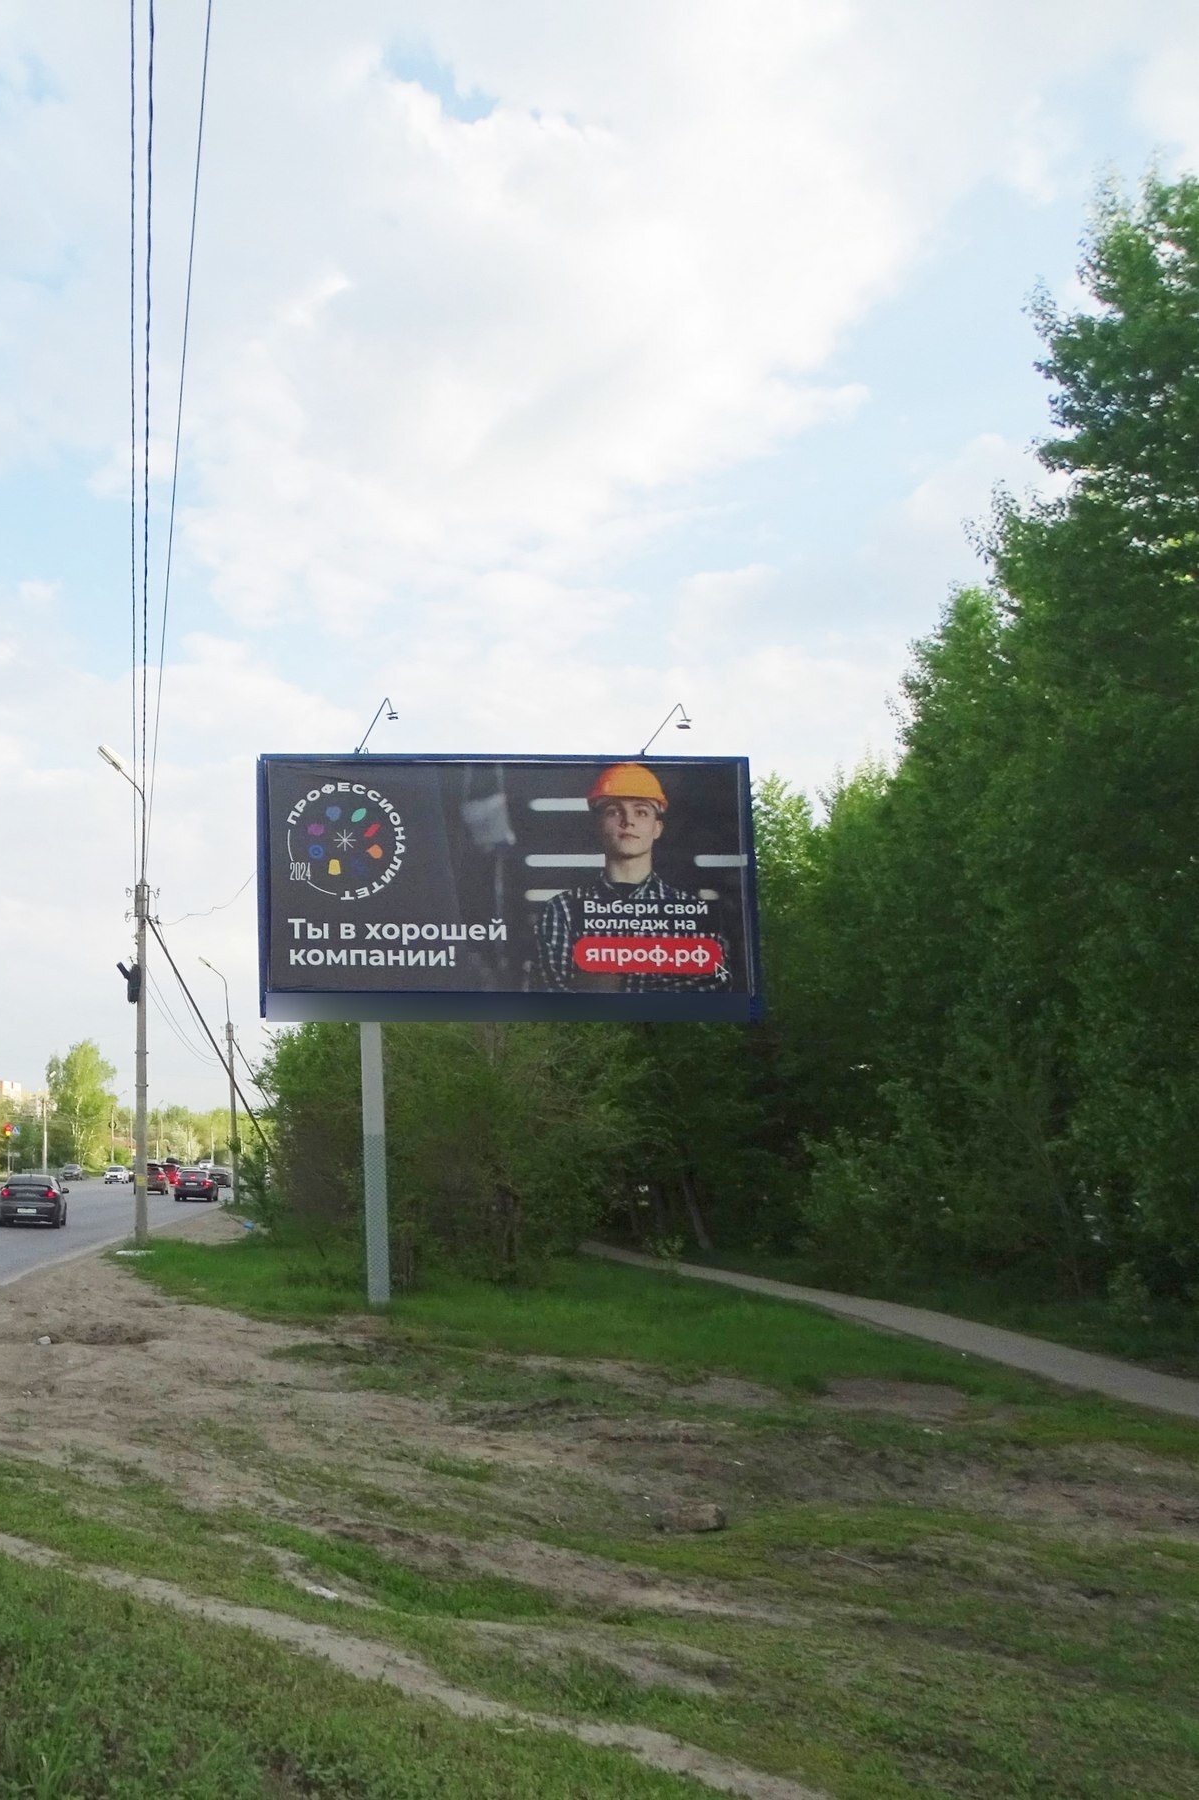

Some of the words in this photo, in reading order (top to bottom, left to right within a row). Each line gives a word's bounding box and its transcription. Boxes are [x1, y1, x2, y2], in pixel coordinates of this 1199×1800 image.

[286, 782, 406, 901] ПРОФЕССИОНАЛИТЕТ
[289, 862, 312, 881] 2024
[583, 900, 659, 917] Выбери
[663, 901, 708, 915] свой
[287, 918, 330, 940] Ты
[339, 922, 356, 940] в
[364, 918, 508, 946] хорошей
[584, 918, 669, 931] колледж
[674, 919, 697, 931] на
[289, 945, 457, 968] компании!
[585, 944, 710, 968] япроф.рф
